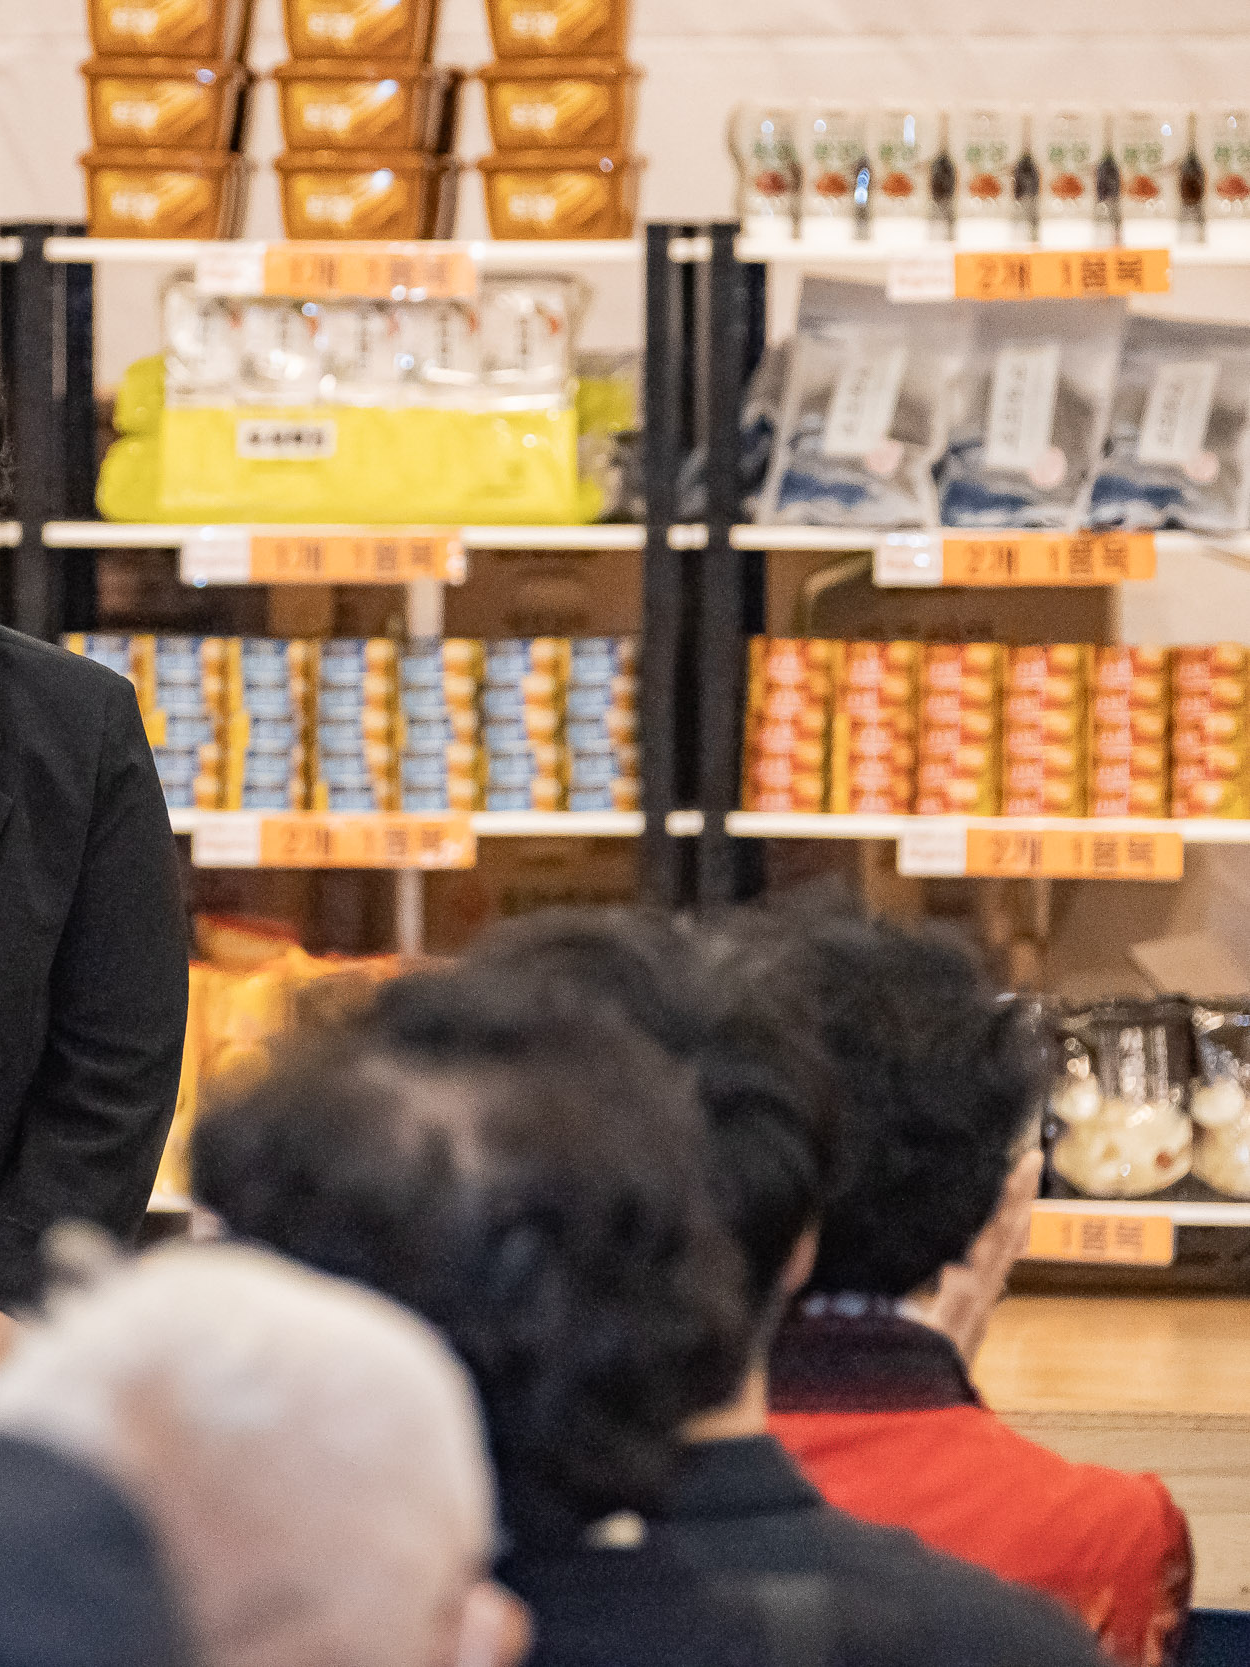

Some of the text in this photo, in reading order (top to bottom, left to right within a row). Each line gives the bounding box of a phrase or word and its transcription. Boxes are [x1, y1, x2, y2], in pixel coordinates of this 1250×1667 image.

[973, 257, 1033, 291] 2개
[1059, 253, 1144, 290] 1품목
[963, 542, 1020, 577] 2개
[986, 836, 1043, 871] 2개
